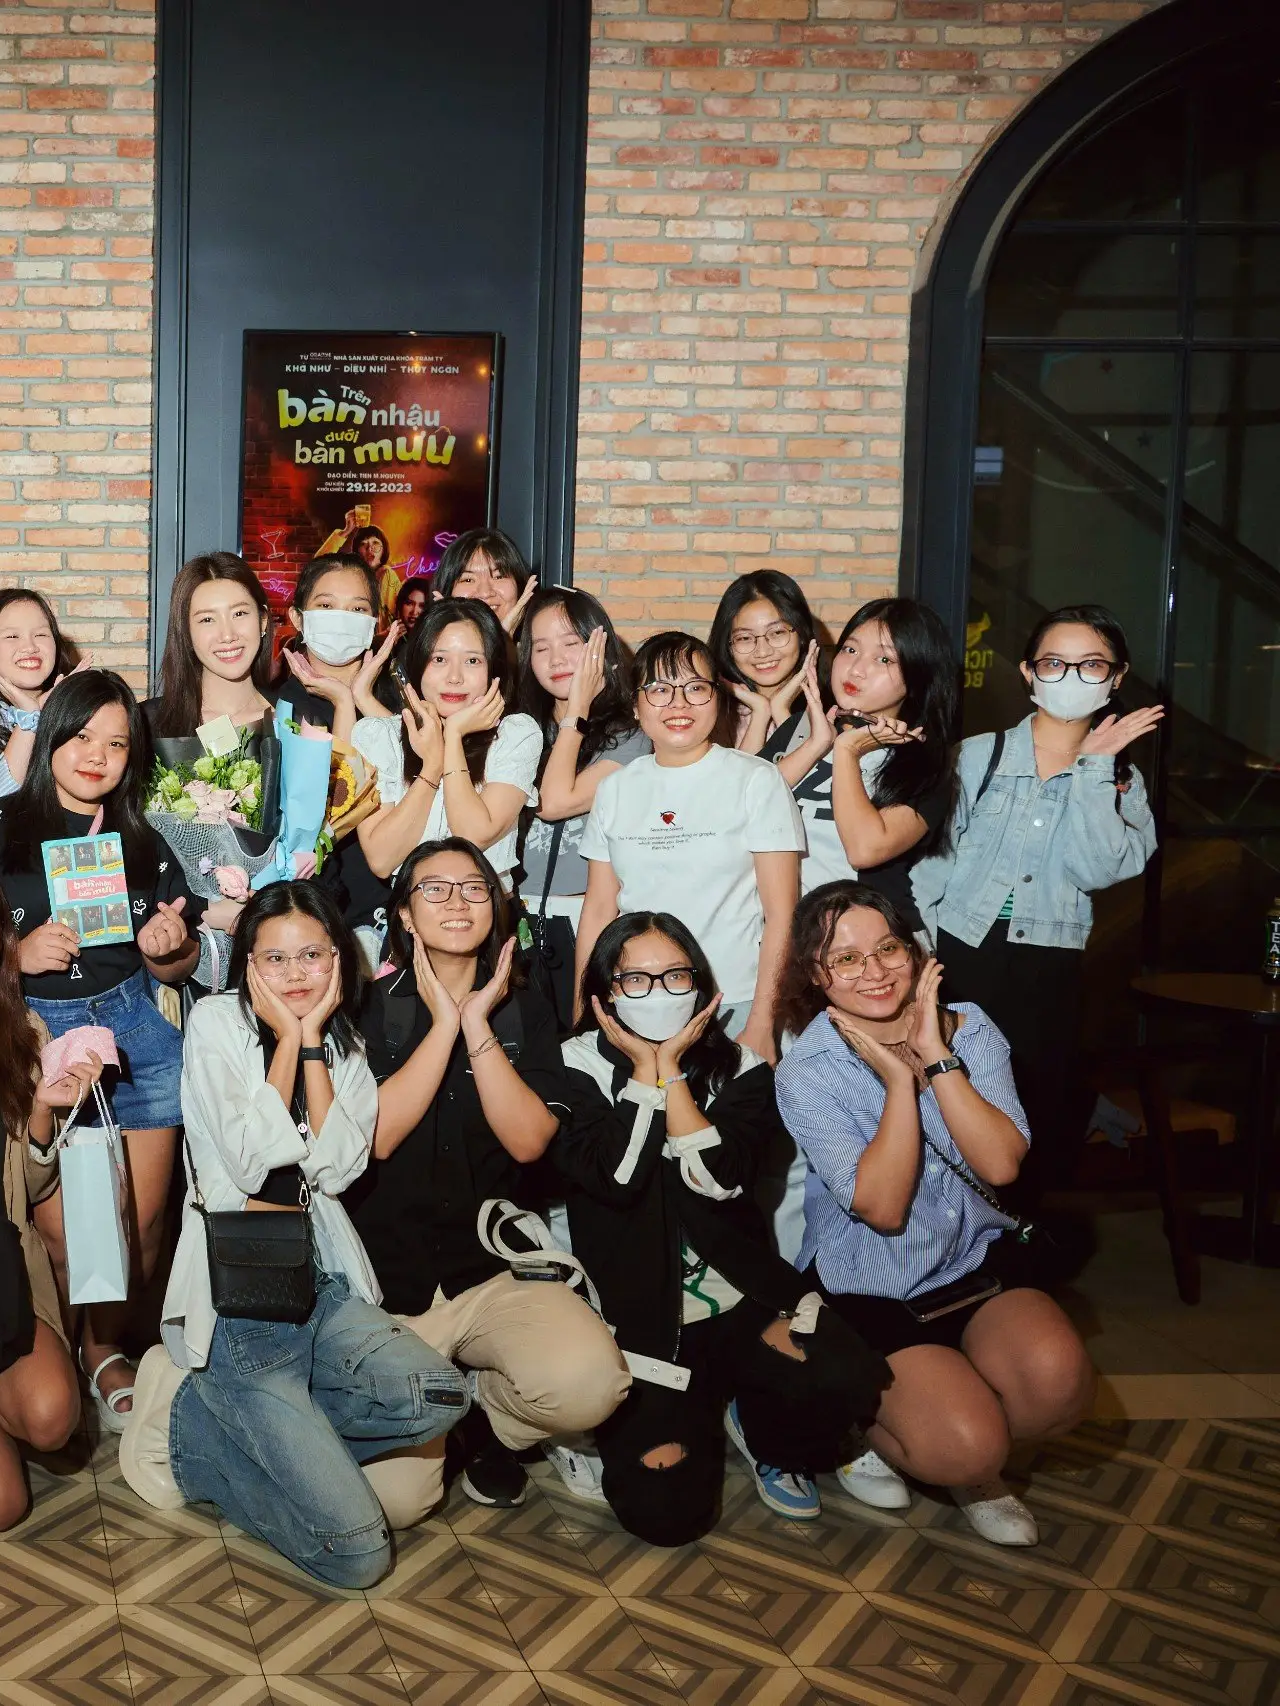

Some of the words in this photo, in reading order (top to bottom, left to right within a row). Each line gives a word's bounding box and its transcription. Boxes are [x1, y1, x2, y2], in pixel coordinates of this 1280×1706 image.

[340, 385, 371, 406] Trên
[277, 389, 368, 428] bàn
[371, 403, 441, 432] nhậu
[325, 428, 360, 443] dưới
[295, 438, 345, 464] bàn
[346, 482, 412, 493] 29.12.2023
